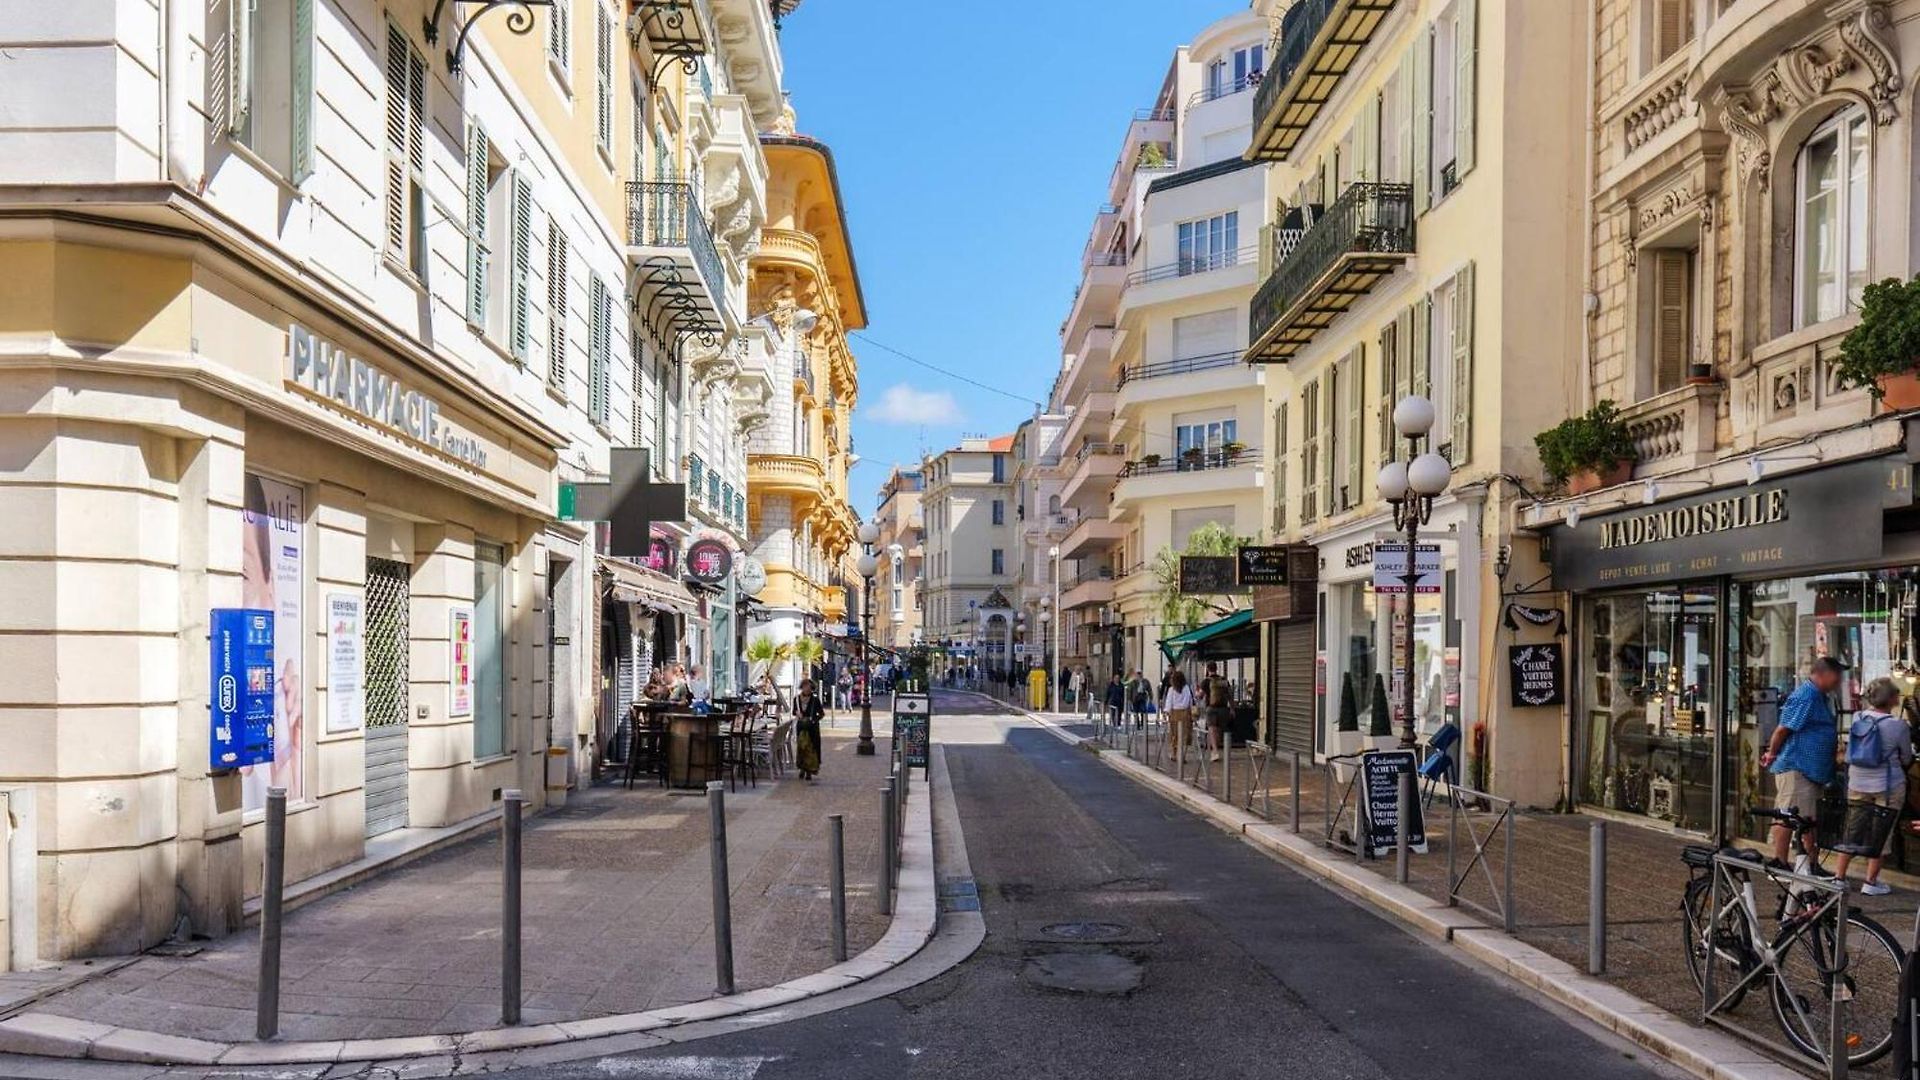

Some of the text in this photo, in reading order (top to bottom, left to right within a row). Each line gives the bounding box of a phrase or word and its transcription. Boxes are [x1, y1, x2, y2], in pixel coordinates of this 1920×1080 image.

[289, 324, 440, 447] PHARMACIE
[1887, 467, 1908, 492] 41
[1599, 488, 1785, 549] MADEMOISELLE
[1345, 541, 1374, 568] ASHLEY
[1691, 557, 1717, 571] ACHAT
[1741, 549, 1783, 563] VINTAGE
[1415, 563, 1440, 571] ARKER
[1522, 661, 1551, 671] CHANEL
[1522, 671, 1553, 681] VUITTON
[222, 677, 234, 710] durex
[1373, 810, 1398, 818] Herme
[1375, 818, 1398, 826] Vuitto
